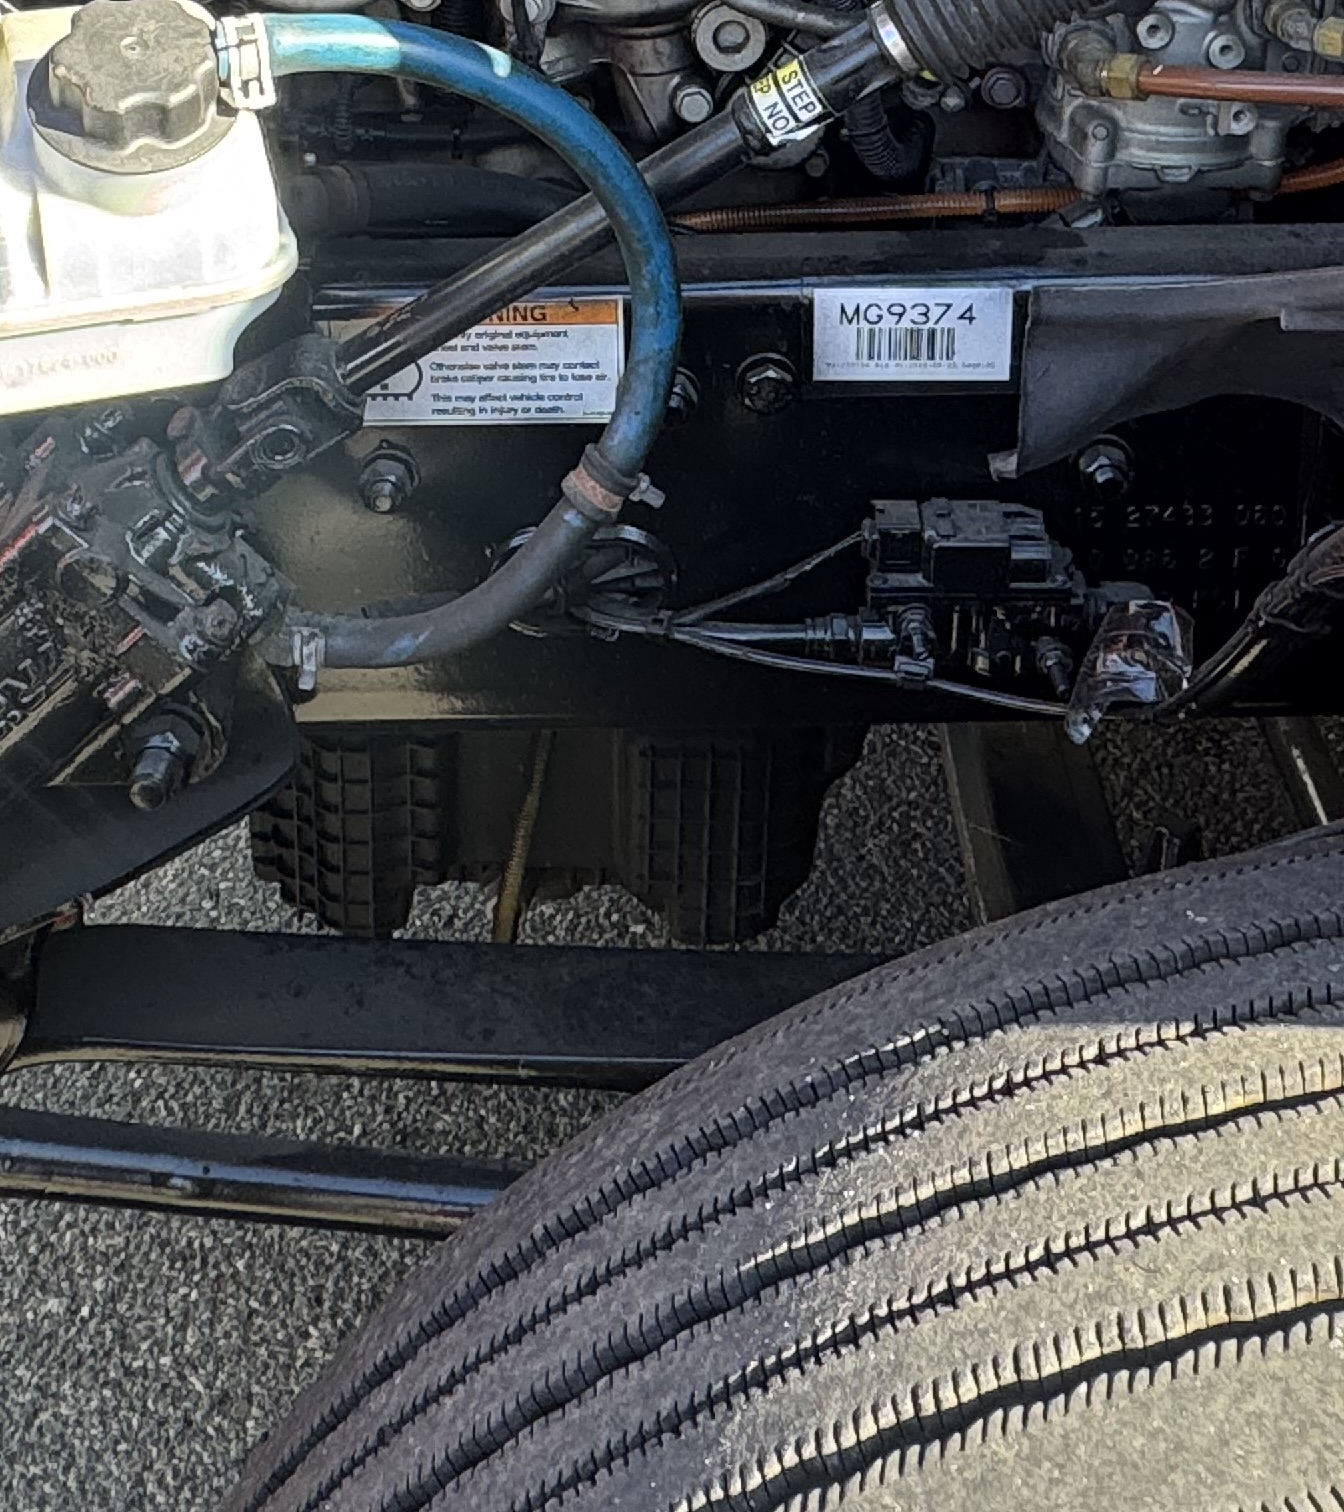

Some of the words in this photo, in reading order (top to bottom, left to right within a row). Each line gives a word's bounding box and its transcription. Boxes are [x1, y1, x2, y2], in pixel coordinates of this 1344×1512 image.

[782, 70, 817, 113] STEP
[763, 100, 790, 131] NO
[839, 302, 977, 326] MG9374
[431, 393, 453, 403] This
